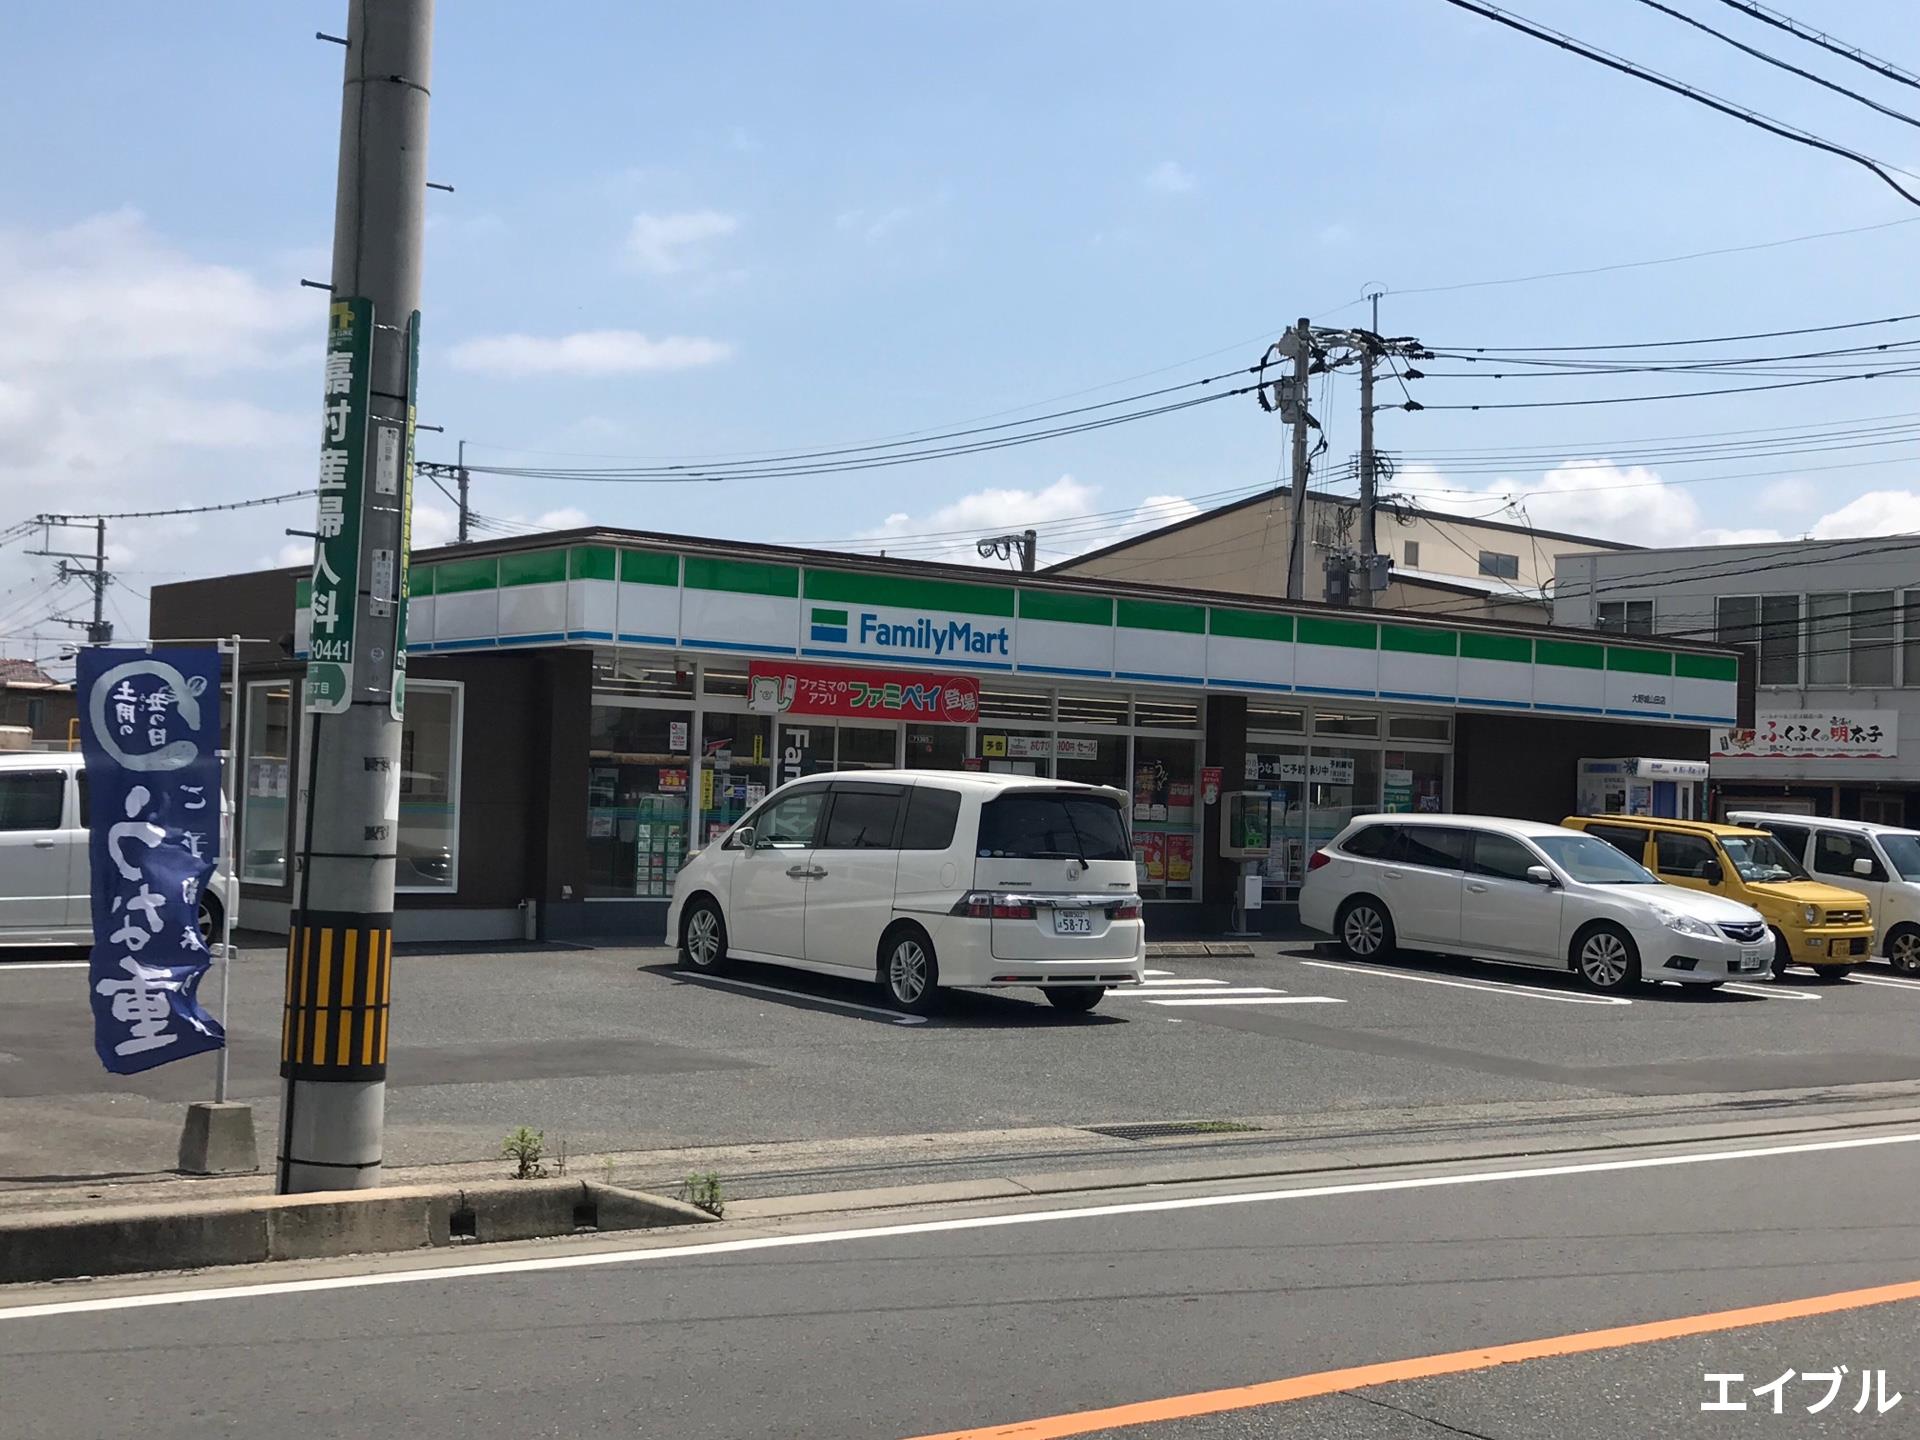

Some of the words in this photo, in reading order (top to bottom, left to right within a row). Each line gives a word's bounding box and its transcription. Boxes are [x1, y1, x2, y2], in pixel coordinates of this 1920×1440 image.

[860, 612, 1009, 656] FamilyMart
[800, 678, 848, 694] ファミマの
[848, 681, 942, 711] ファミペイ
[808, 692, 837, 705] アプリ
[943, 687, 977, 711] 登場
[1760, 720, 1884, 744] ふくふくの明太子
